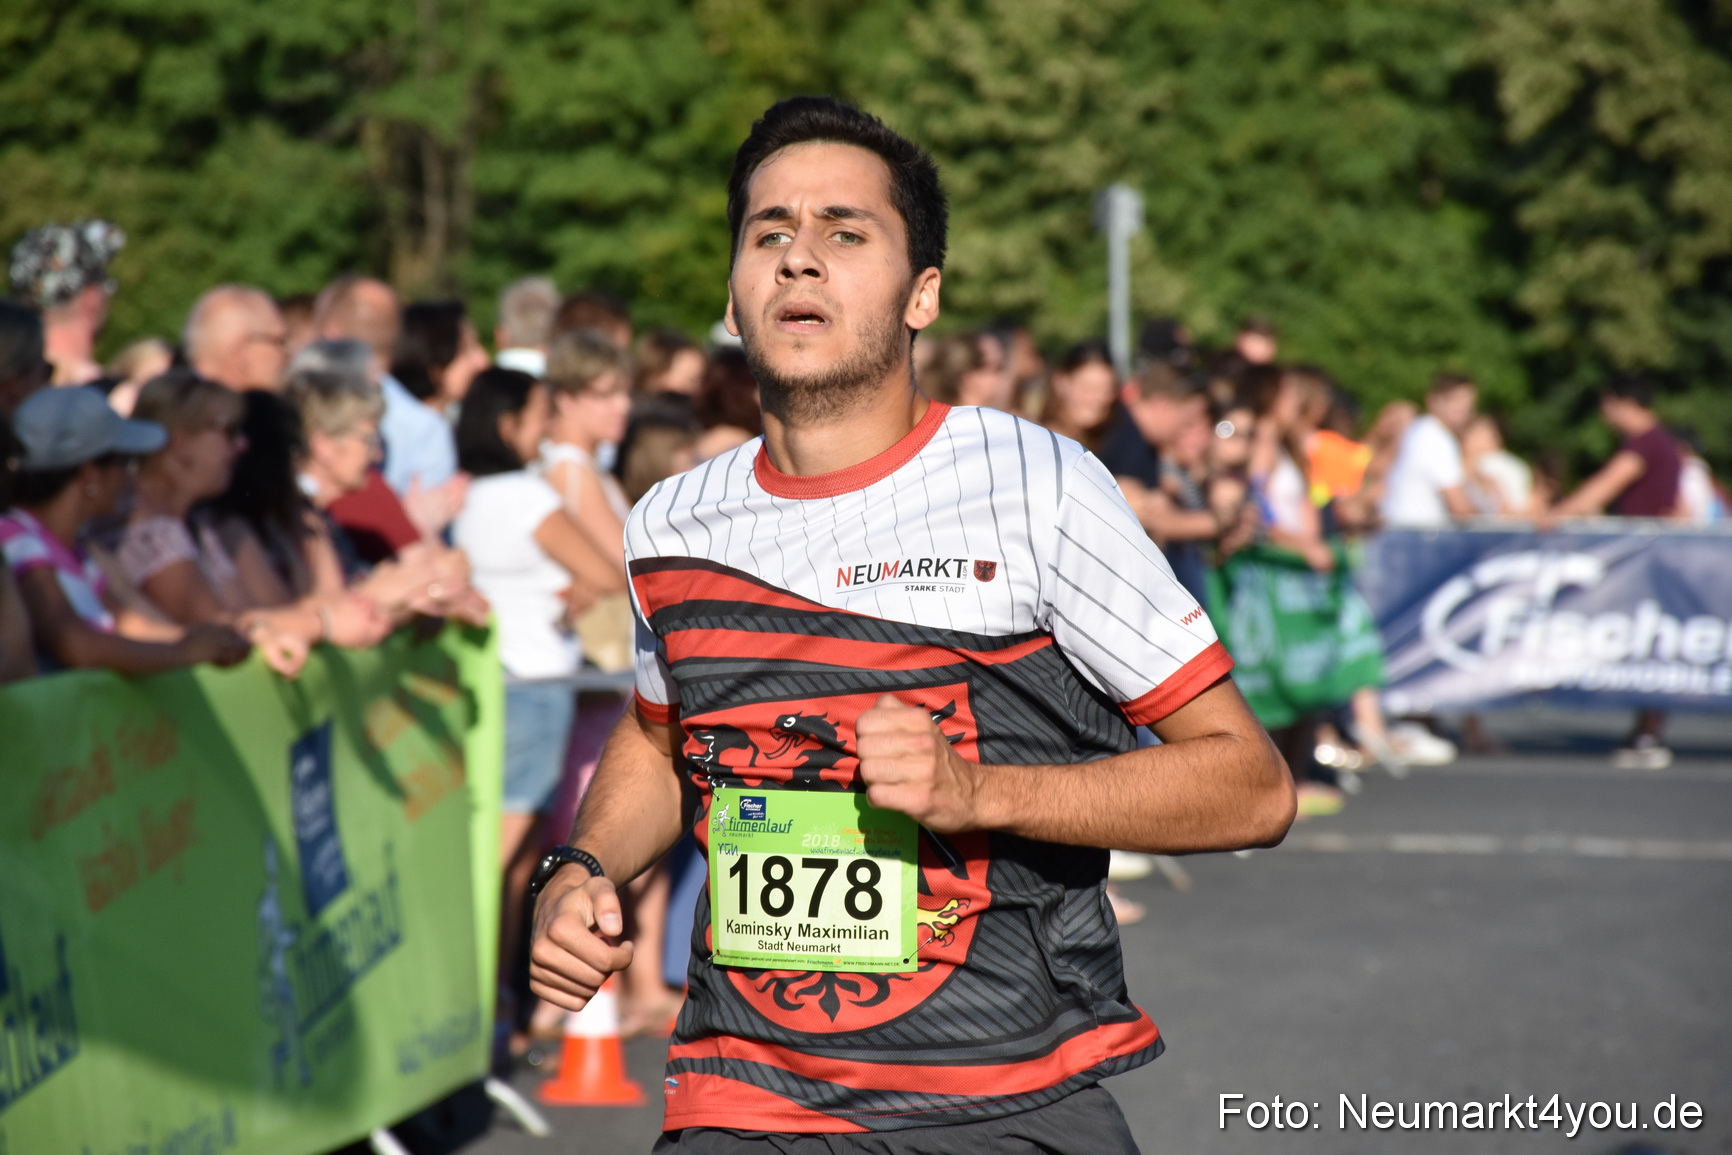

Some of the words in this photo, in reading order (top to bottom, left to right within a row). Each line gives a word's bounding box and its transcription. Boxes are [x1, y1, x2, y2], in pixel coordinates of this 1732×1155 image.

[836, 558, 968, 588] NEUMARKT
[939, 586, 965, 594] STADT
[1479, 598, 1732, 667] Fische
[729, 817, 794, 834] firmenlauf
[801, 834, 841, 848] 2018
[729, 853, 883, 921] 1878
[726, 919, 792, 940] Kaminsky
[797, 923, 889, 940] Maximilian
[758, 940, 784, 951] Stadt
[786, 941, 841, 953] Neumarkt
